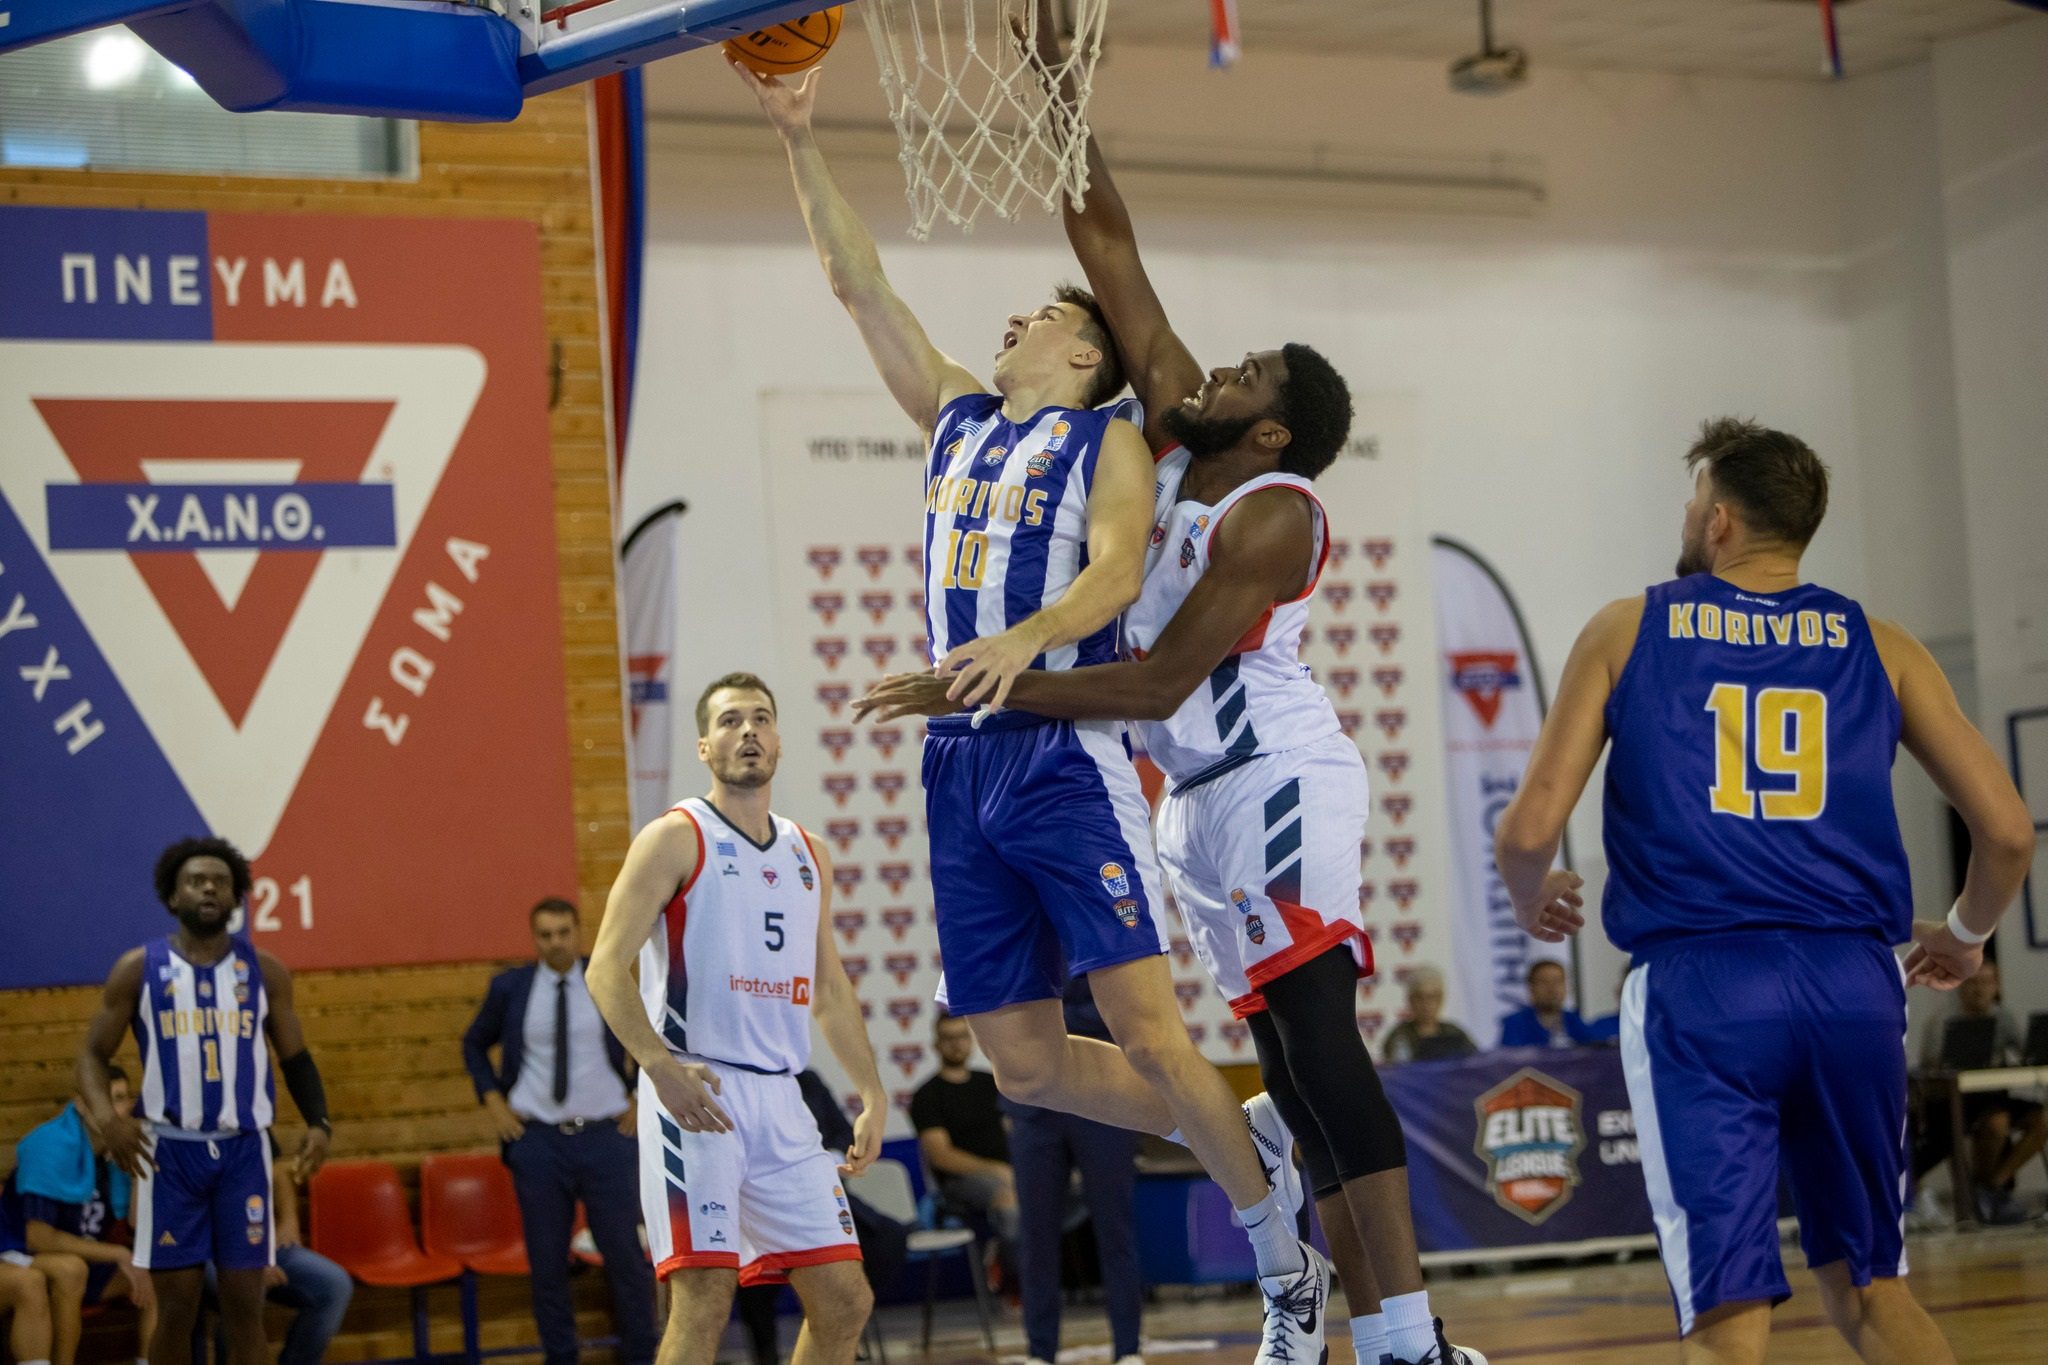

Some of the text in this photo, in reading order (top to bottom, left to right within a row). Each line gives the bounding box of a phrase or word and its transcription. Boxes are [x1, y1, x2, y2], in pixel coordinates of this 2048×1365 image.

[61, 253, 358, 308] ΠΝΕΥΜΑ
[126, 493, 326, 543] Χ.Α.Ν.Θ.
[941, 528, 990, 590] 10
[362, 535, 491, 746] ΣΩΜΑ
[1668, 603, 1849, 648] KORIVOS
[0, 558, 106, 757] ΥΧΗ
[1703, 682, 1828, 821] 19
[764, 911, 785, 952] 5
[159, 1006, 254, 1039] KORIVOS
[203, 1039, 221, 1082] 1
[1484, 1104, 1579, 1149] ELITE
